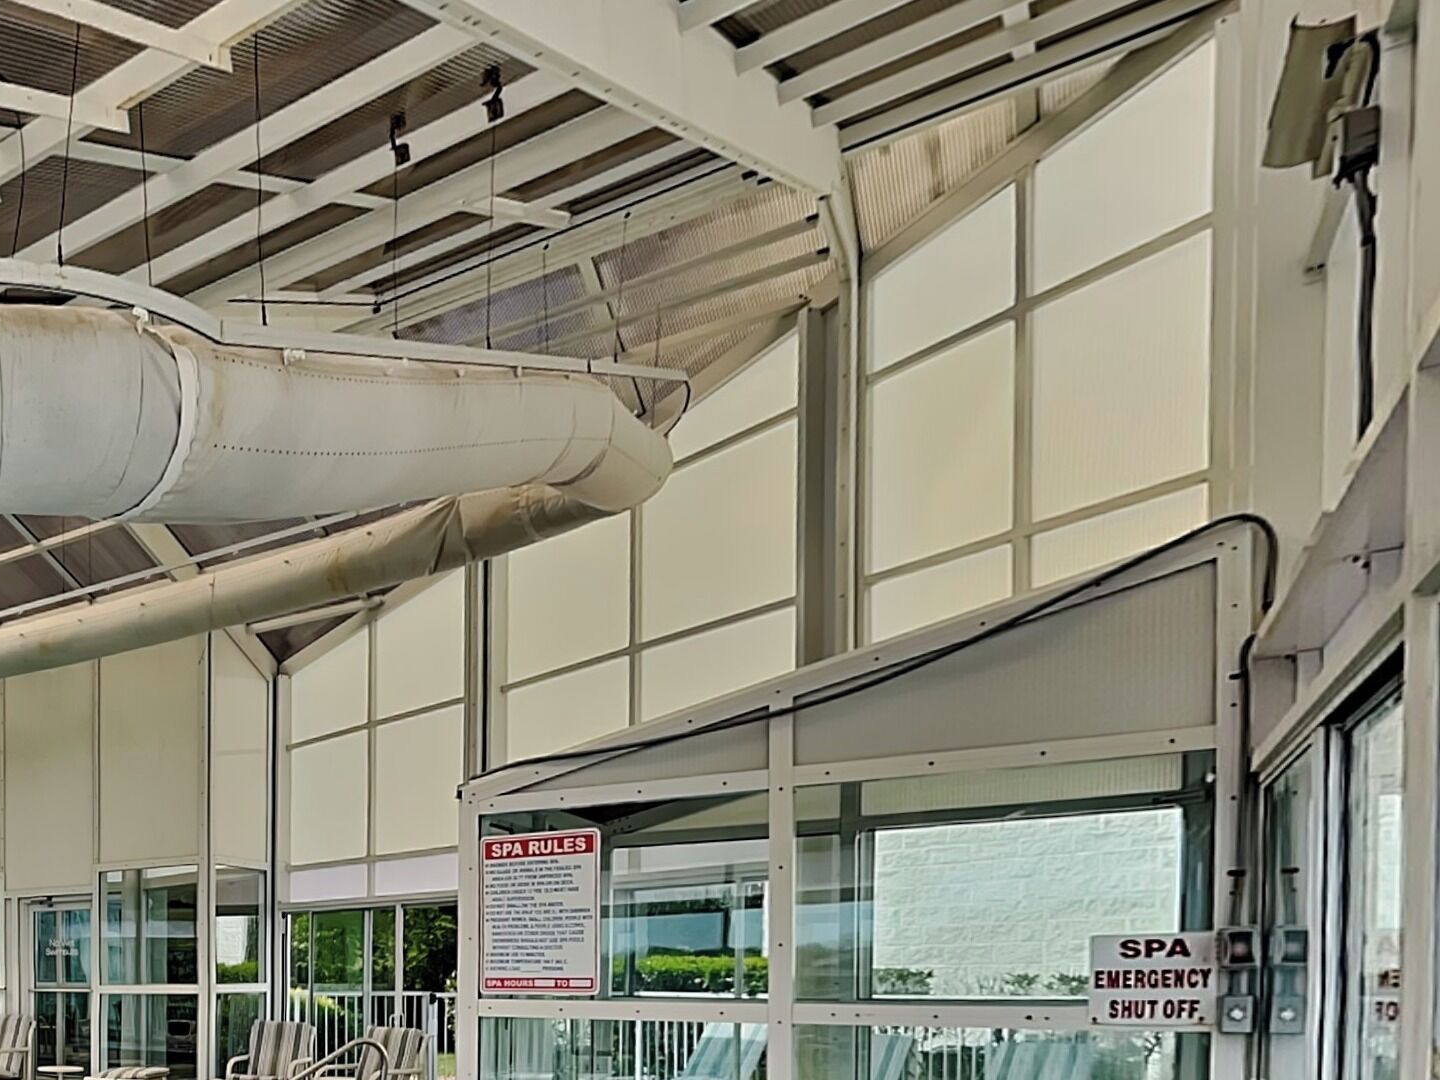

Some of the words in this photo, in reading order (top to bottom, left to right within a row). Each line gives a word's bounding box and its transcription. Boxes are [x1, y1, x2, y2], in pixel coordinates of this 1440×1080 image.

[491, 841, 523, 857] SPA
[528, 837, 587, 855] RULES
[1119, 938, 1191, 959] SPA
[1094, 968, 1212, 989] EMERGENCY
[1109, 1000, 1158, 1019] SHUT
[1163, 1000, 1200, 1019] OFF
